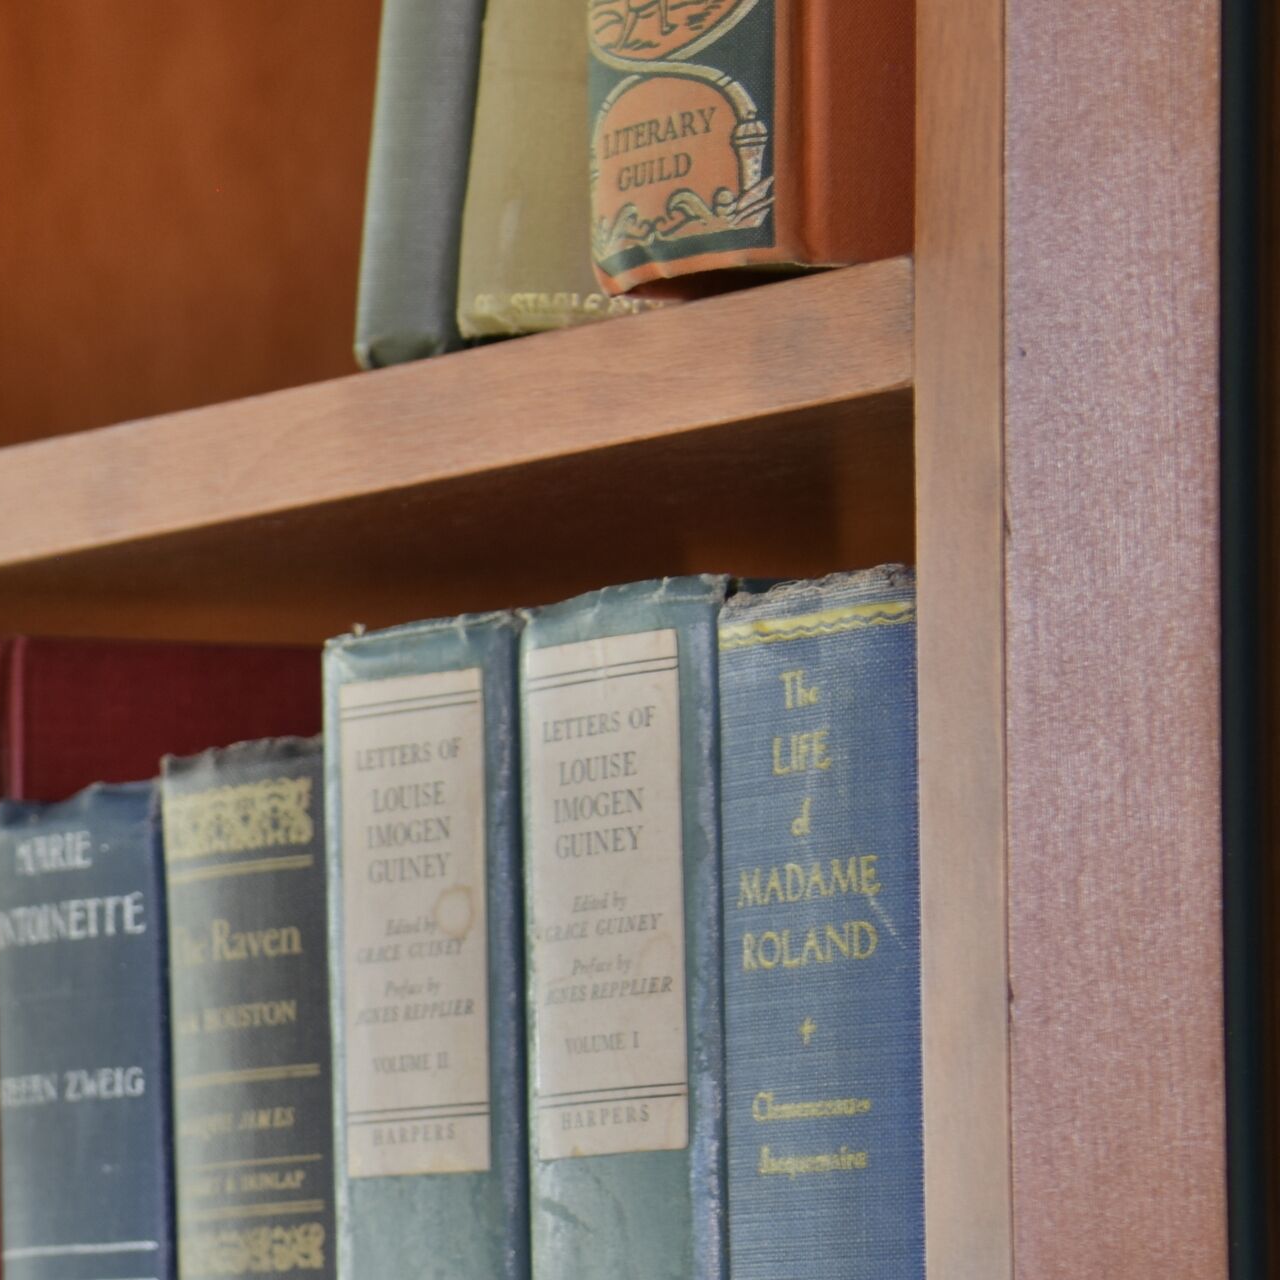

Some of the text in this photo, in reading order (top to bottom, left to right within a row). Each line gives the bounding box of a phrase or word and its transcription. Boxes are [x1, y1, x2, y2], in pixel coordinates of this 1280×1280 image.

[603, 107, 717, 160] LITERARY
[618, 152, 693, 192] GUILD
[779, 668, 820, 709] The
[542, 705, 657, 743] LETTERS OF
[356, 736, 462, 772] LETTERS OF
[559, 750, 638, 786] LOUISE
[772, 729, 833, 776] LIFE
[372, 780, 446, 814] LOUISE
[553, 787, 645, 823] IMOGEN
[367, 815, 451, 849] IMOGEN
[555, 825, 645, 860] GUINEY
[14, 830, 93, 876] MARIE
[368, 851, 452, 884] GUINEY
[738, 854, 882, 908] MADAME
[571, 890, 629, 913] Edited by
[210, 918, 303, 962] Raven
[544, 912, 664, 943] GRACE GUINEY
[742, 919, 880, 971] ROLAND
[571, 953, 632, 976] Preface by
[590, 976, 673, 1000] REPPLIER
[203, 1000, 297, 1034] HOUSTON
[403, 998, 475, 1022] REPPLIER
[565, 1030, 641, 1056] VOLUME I
[372, 1053, 431, 1075] VOLUME
[64, 1065, 146, 1102] ZWEIG
[239, 1106, 297, 1131] JAMES
[373, 1122, 455, 1147] HARPERS
[561, 1104, 650, 1131] HARPERS
[240, 1169, 305, 1193] DUNLAP
